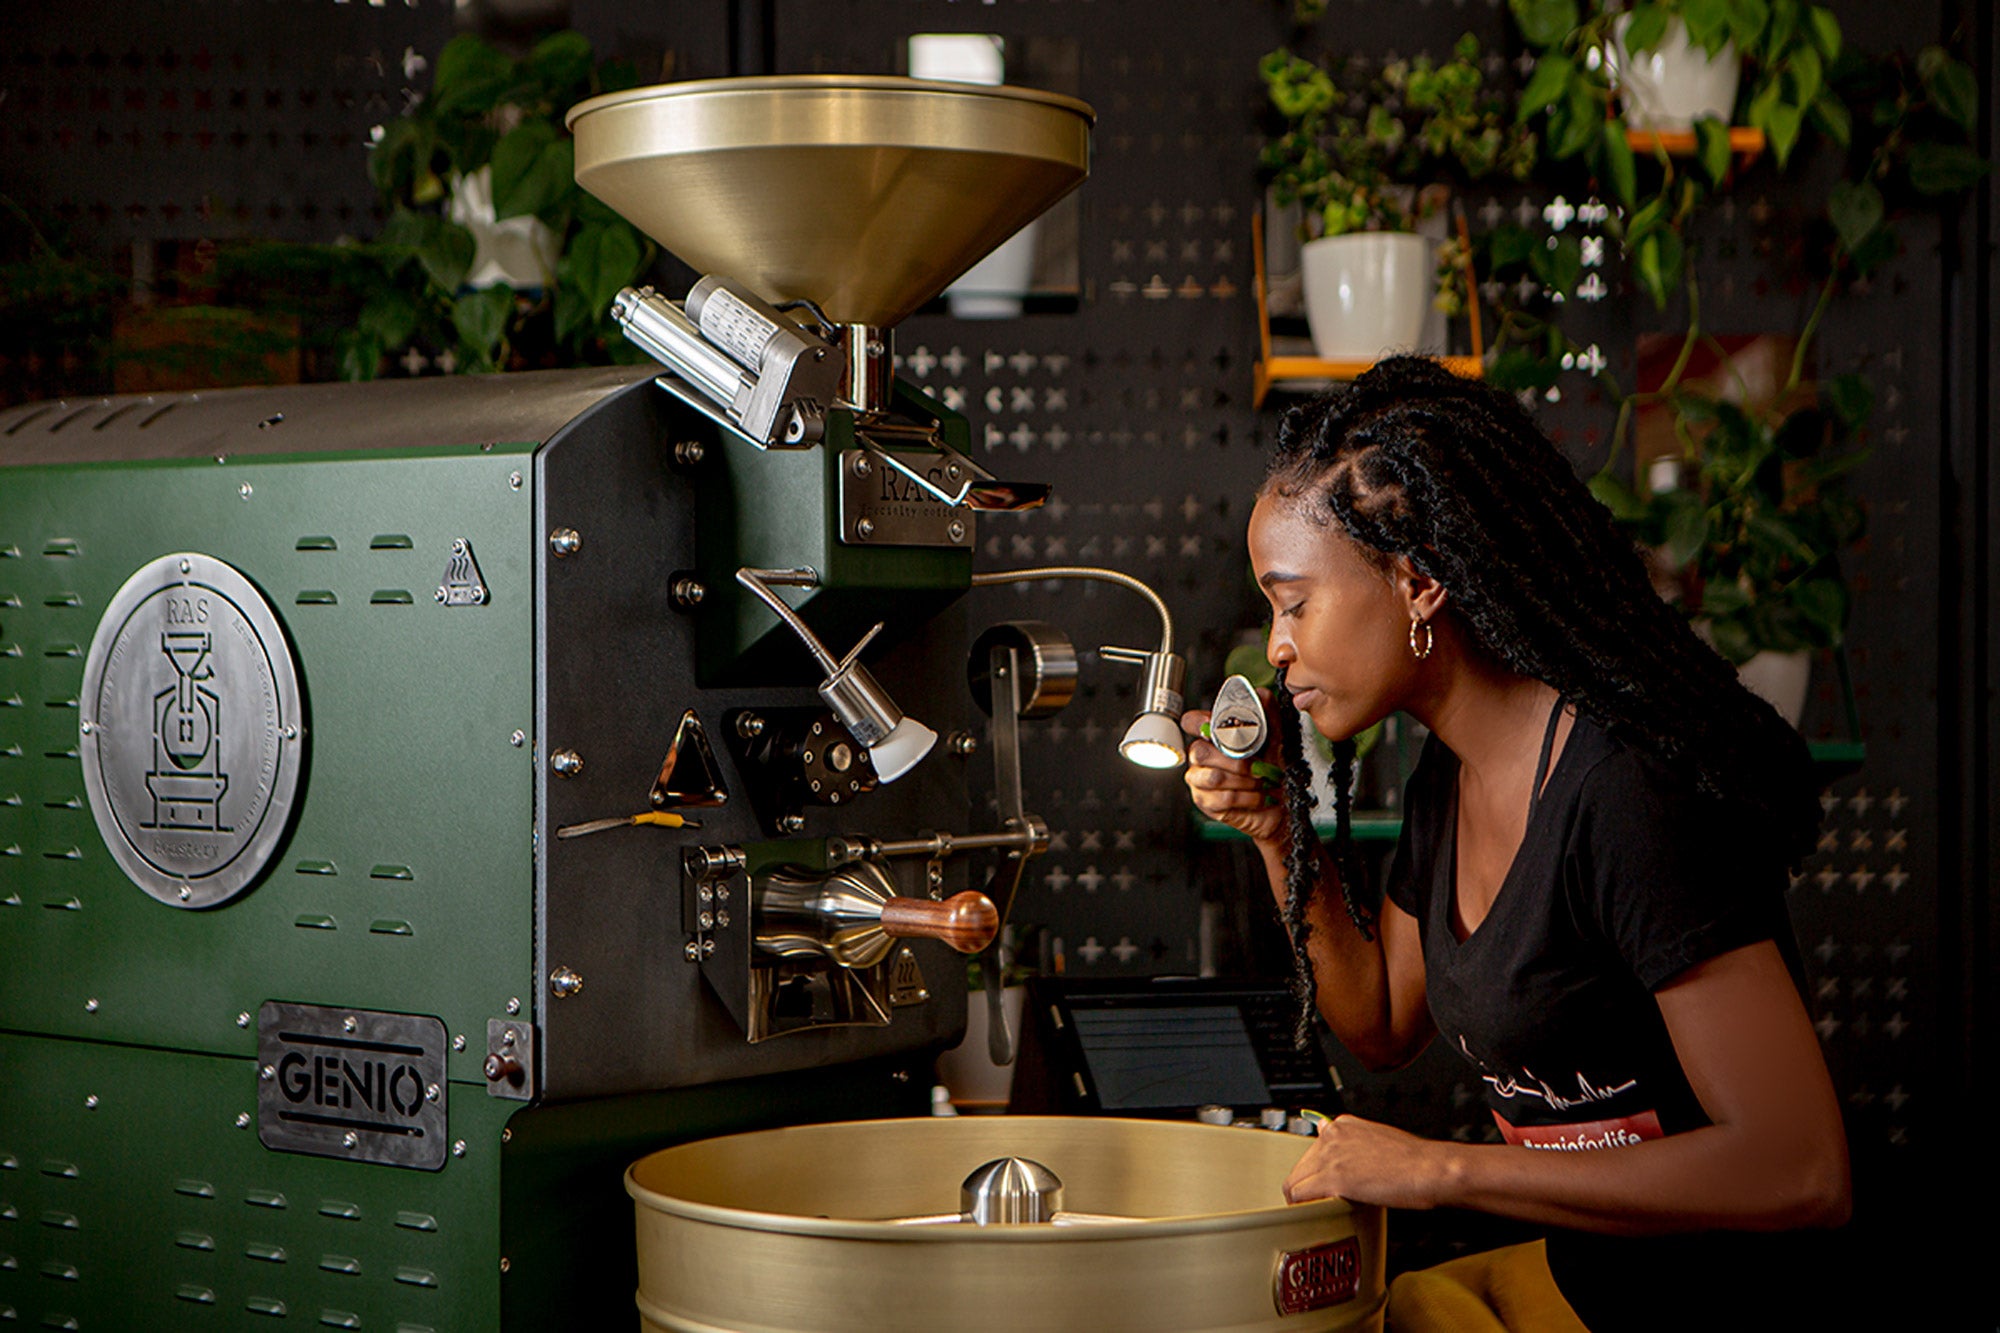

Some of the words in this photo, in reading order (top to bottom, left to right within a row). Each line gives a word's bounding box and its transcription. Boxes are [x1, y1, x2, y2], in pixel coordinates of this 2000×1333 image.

[166, 598, 209, 624] RAS
[278, 1052, 425, 1117] GENIO
[1289, 1248, 1355, 1289] GENIO
